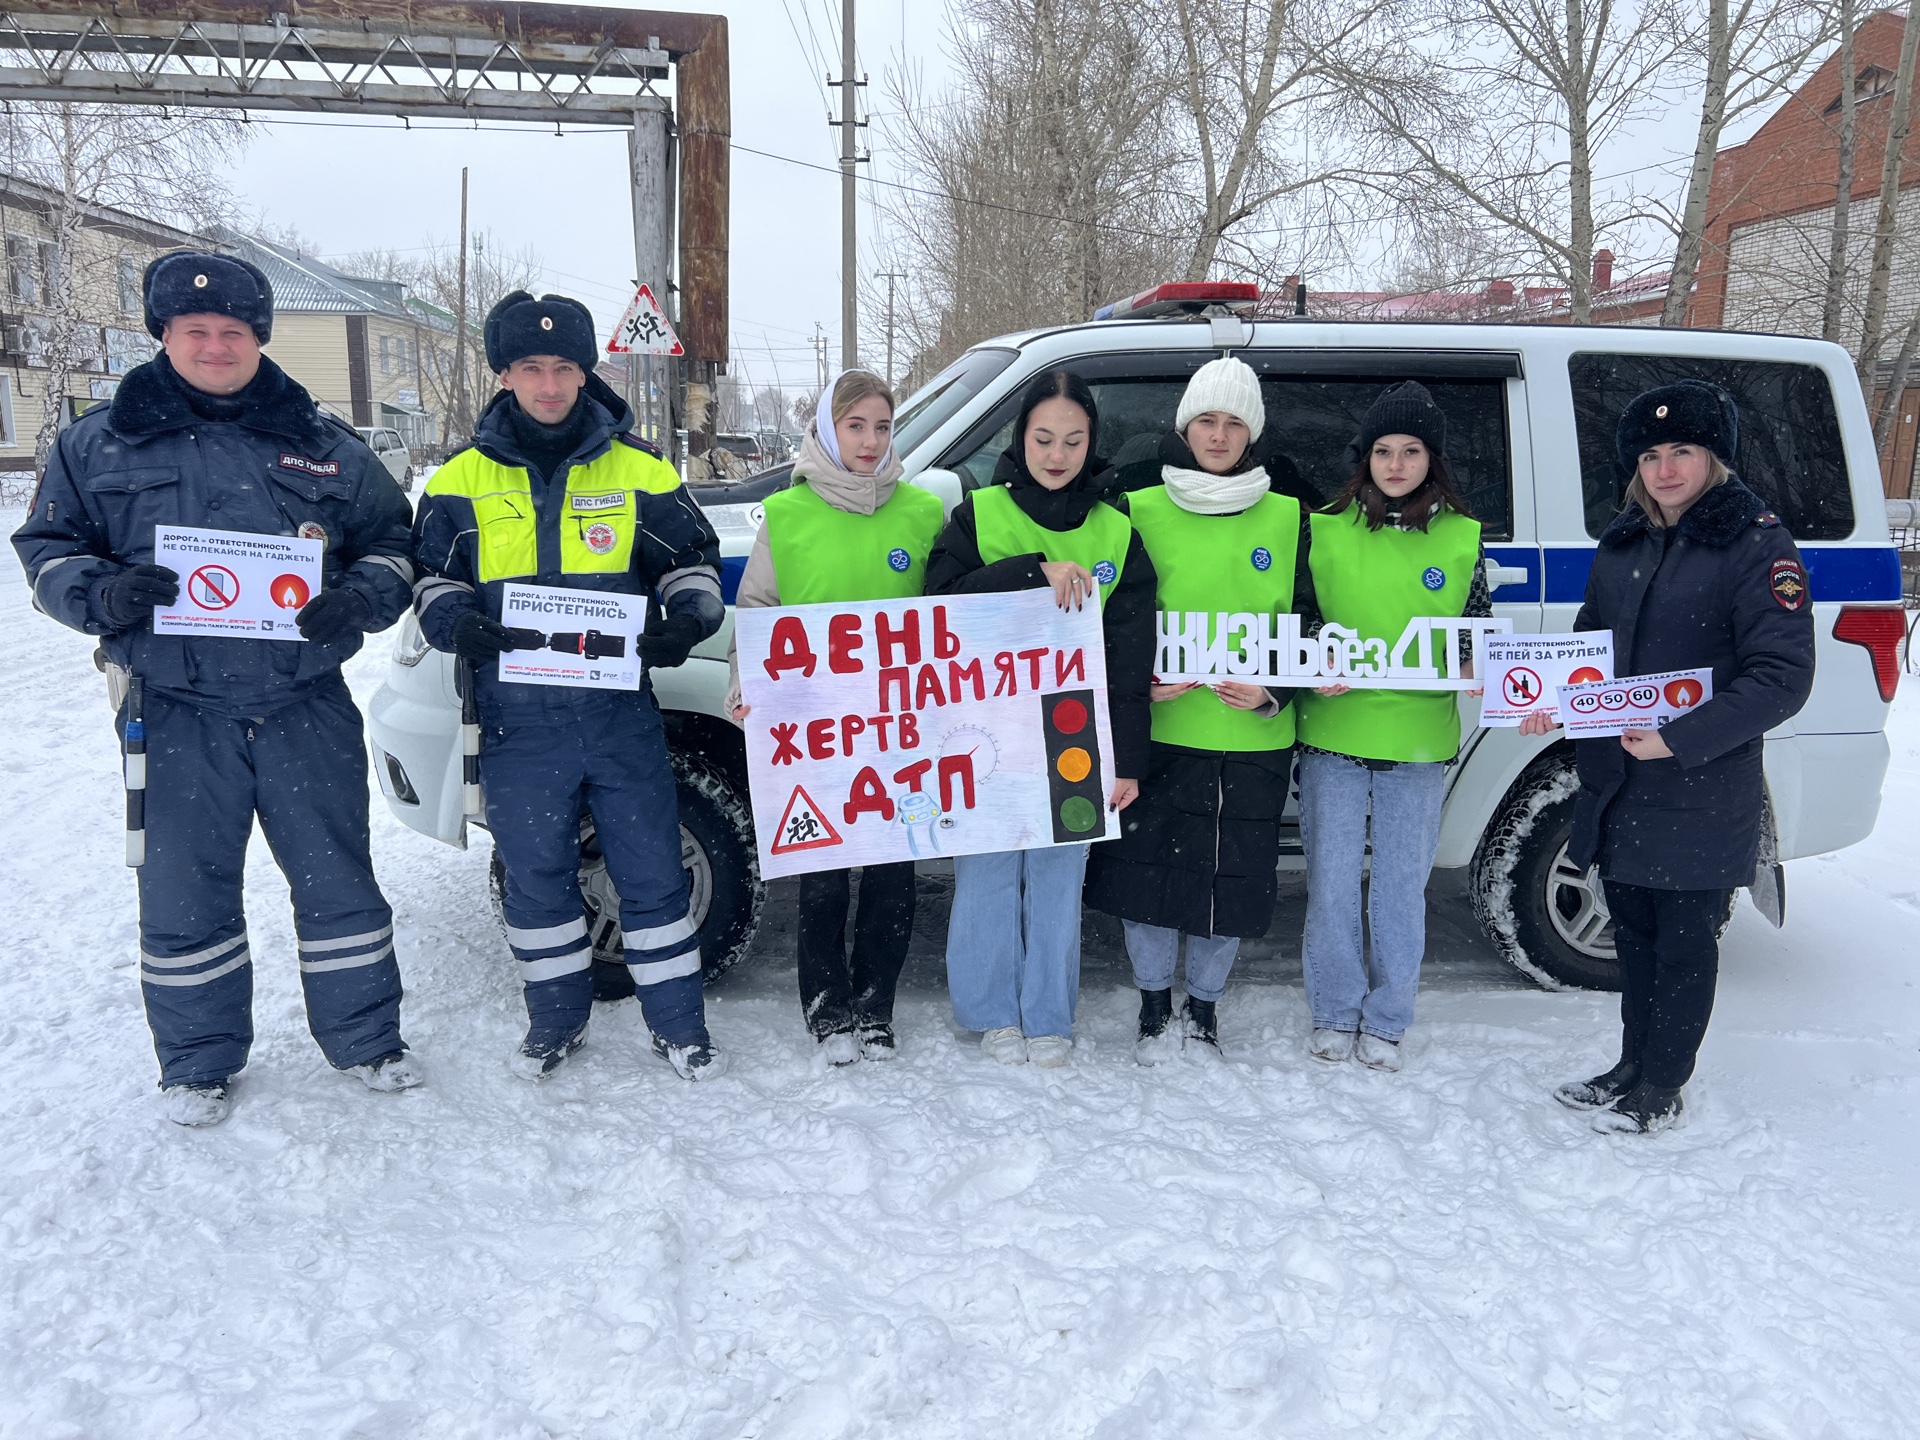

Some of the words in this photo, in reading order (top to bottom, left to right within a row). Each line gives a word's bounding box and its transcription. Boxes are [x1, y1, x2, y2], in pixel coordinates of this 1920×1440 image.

[283, 456, 304, 467] ДПС
[306, 460, 336, 473] ГИБДД
[574, 498, 593, 507] ДПС
[595, 495, 623, 506] ГИБДД
[163, 534, 199, 543] ДОРОГА
[208, 538, 292, 551] ОТВЕТСТВЕННОСТЬ
[163, 543, 177, 551] НЕ
[180, 544, 247, 557] ОТВЛЕКАЙСЯ
[249, 550, 263, 558] НА
[265, 552, 315, 563] ГАДЖЕТЫ
[1774, 571, 1799, 580] РОССИЯ
[510, 591, 541, 599] ДОРОГА
[548, 595, 620, 607] ОТВЕТСТВЕННОСТЬ
[508, 599, 628, 620] ПРИСТЕГНИСЬ
[763, 605, 960, 681] ДЕНЬ
[1516, 640, 1585, 648] ОТВЕТСТВЕННОСТЬ
[1489, 651, 1503, 660] НЕ
[1506, 649, 1530, 660] ПЕЙ
[1534, 650, 1553, 660] ЗА
[1557, 646, 1608, 659] РУЛЕМ
[878, 647, 1085, 712] ПАМЯТИ
[1577, 697, 1594, 706] 40
[1604, 694, 1623, 704] 50
[1633, 689, 1653, 700] 60
[769, 712, 920, 766] ЖЕРТВ
[843, 754, 976, 824] ДТП
